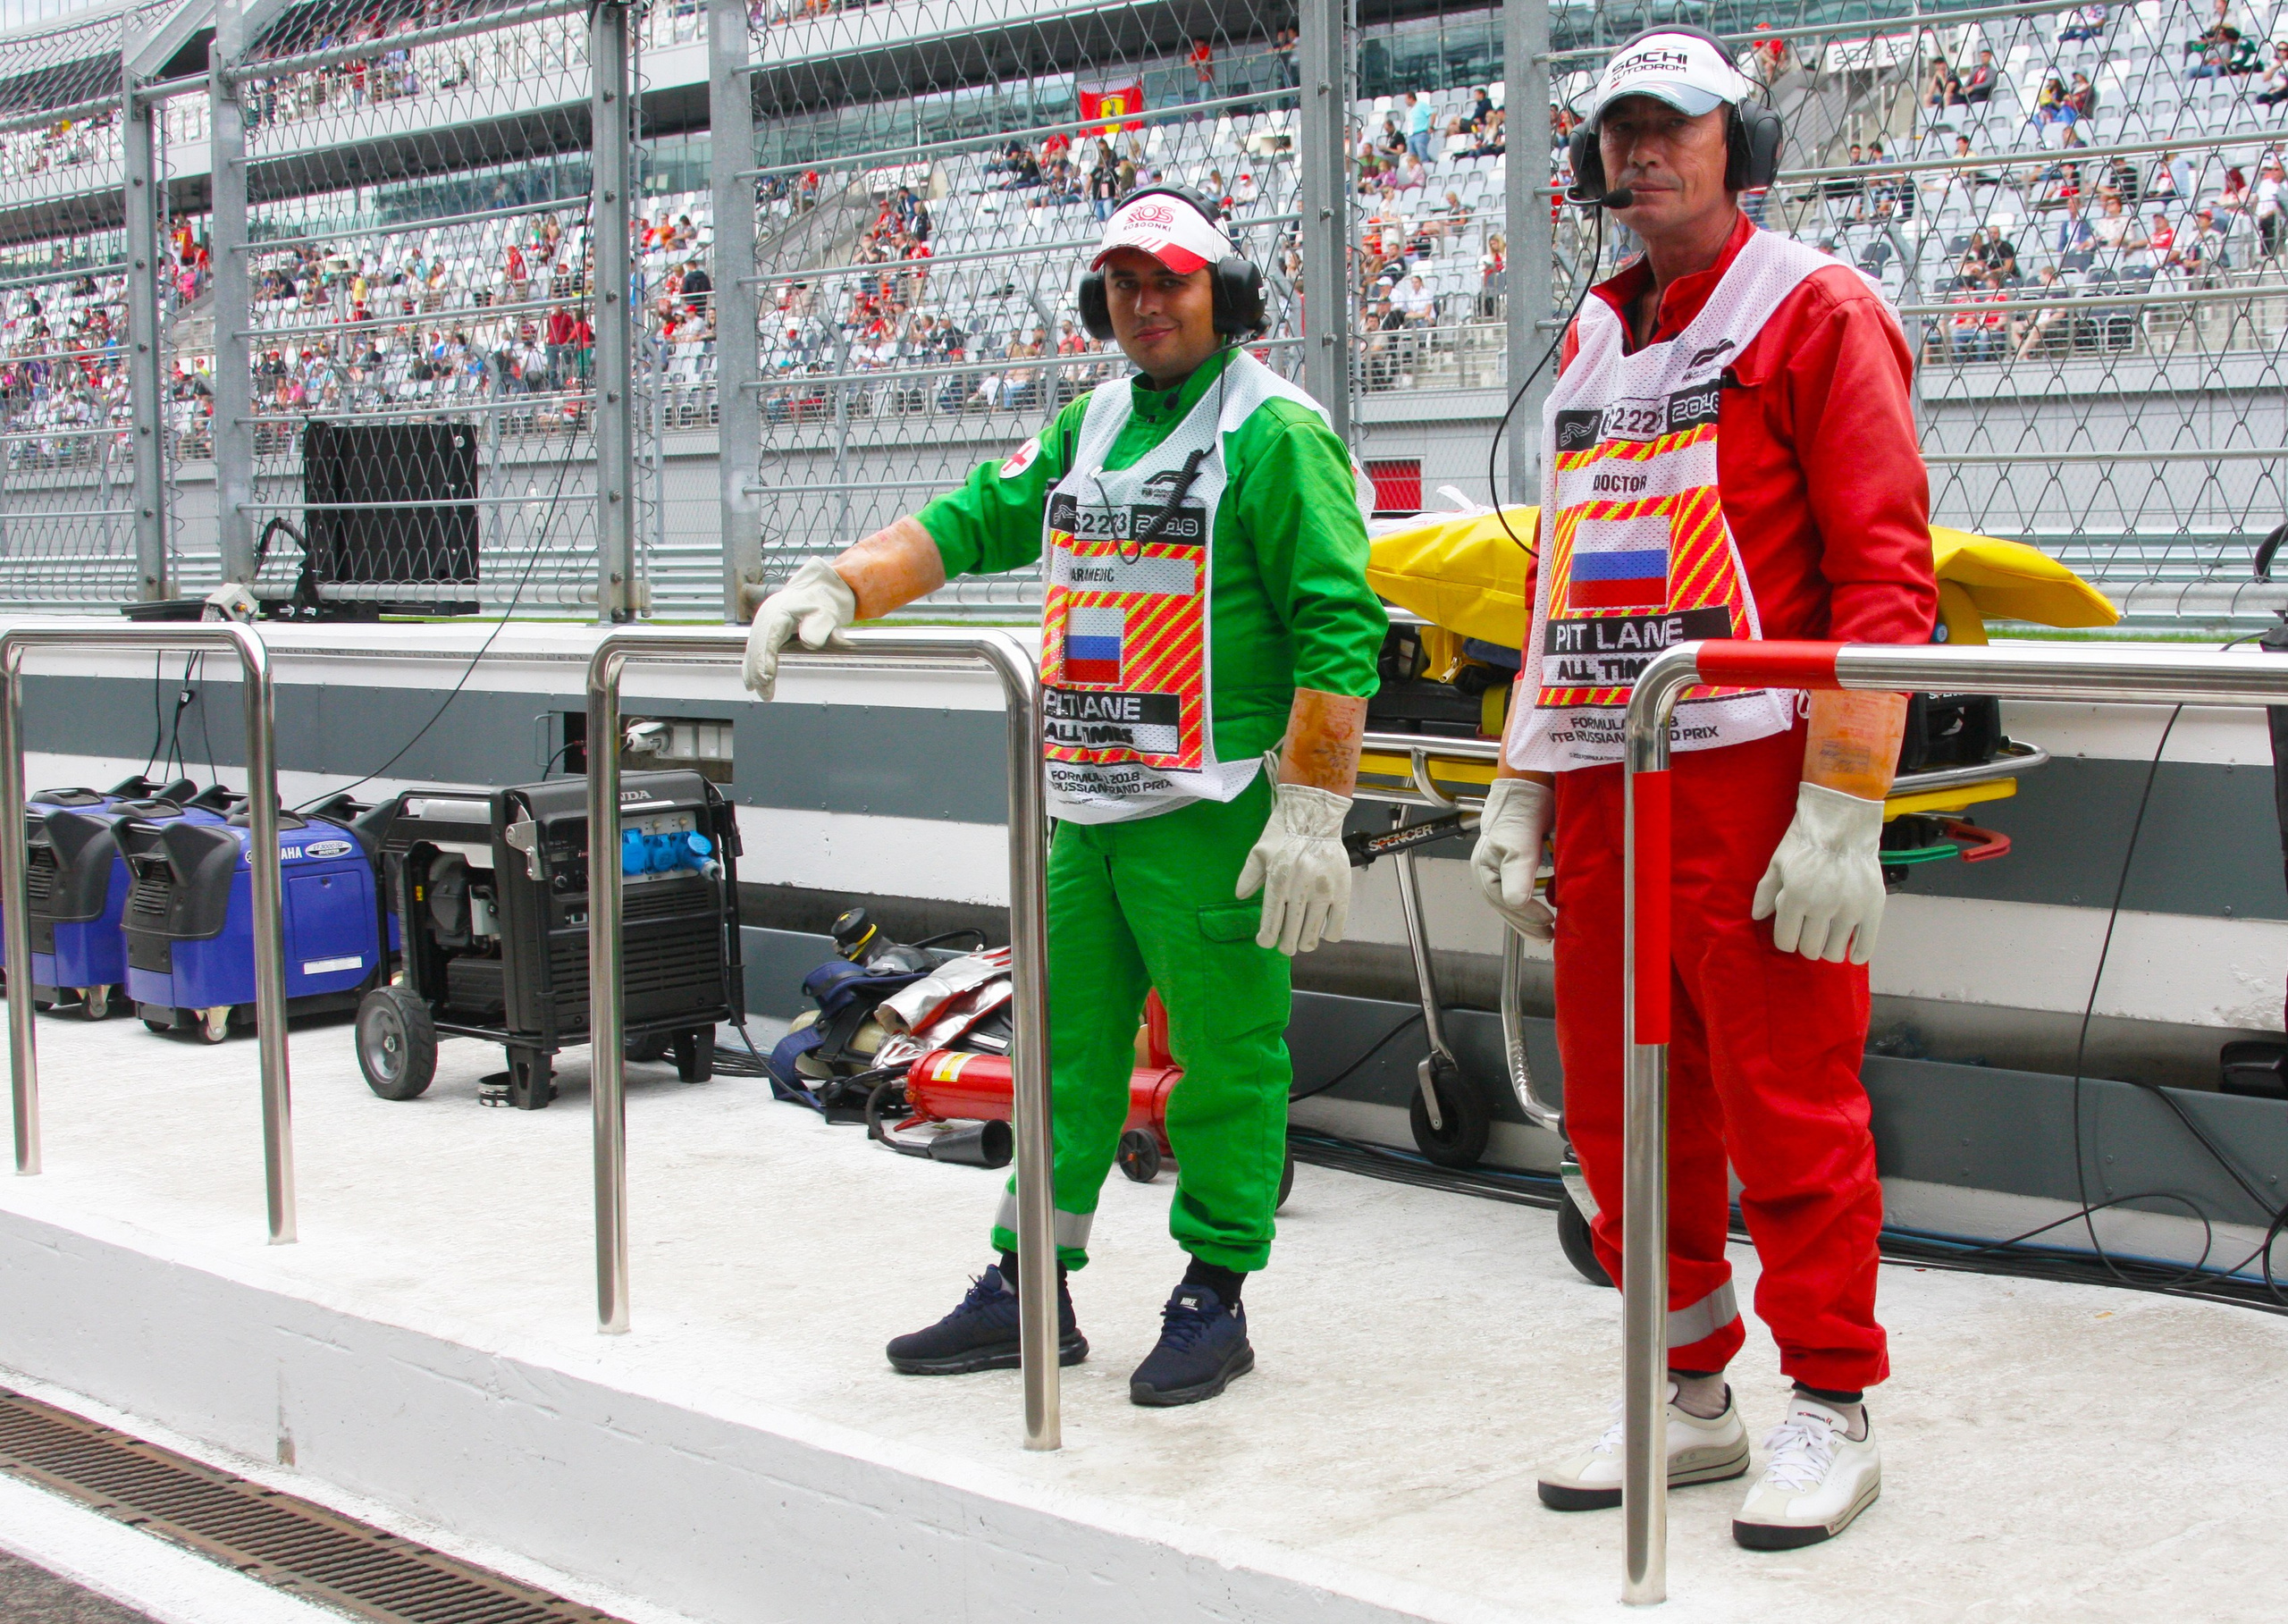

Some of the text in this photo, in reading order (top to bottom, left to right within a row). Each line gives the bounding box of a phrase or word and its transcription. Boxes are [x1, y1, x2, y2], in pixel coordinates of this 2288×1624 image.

[1611, 52, 1687, 76] SOCHI
[1611, 63, 1687, 83] AUTODROM
[1593, 475, 1648, 492] DOCTOR
[1555, 618, 1684, 651] PIT LANE
[1557, 657, 1653, 681] ALL TIM
[1044, 689, 1075, 717] PIT
[1044, 721, 1082, 742] ALL
[1575, 729, 1625, 744] RUSSIAN
[1683, 725, 1720, 741] PRIX
[1051, 770, 1140, 784] FORMUL 2018
[620, 790, 652, 801] NDA
[1107, 783, 1141, 795] RAND
[1367, 824, 1434, 852] SPENCER
[281, 846, 303, 860] AHA
[1180, 1297, 1198, 1307] NIKE
